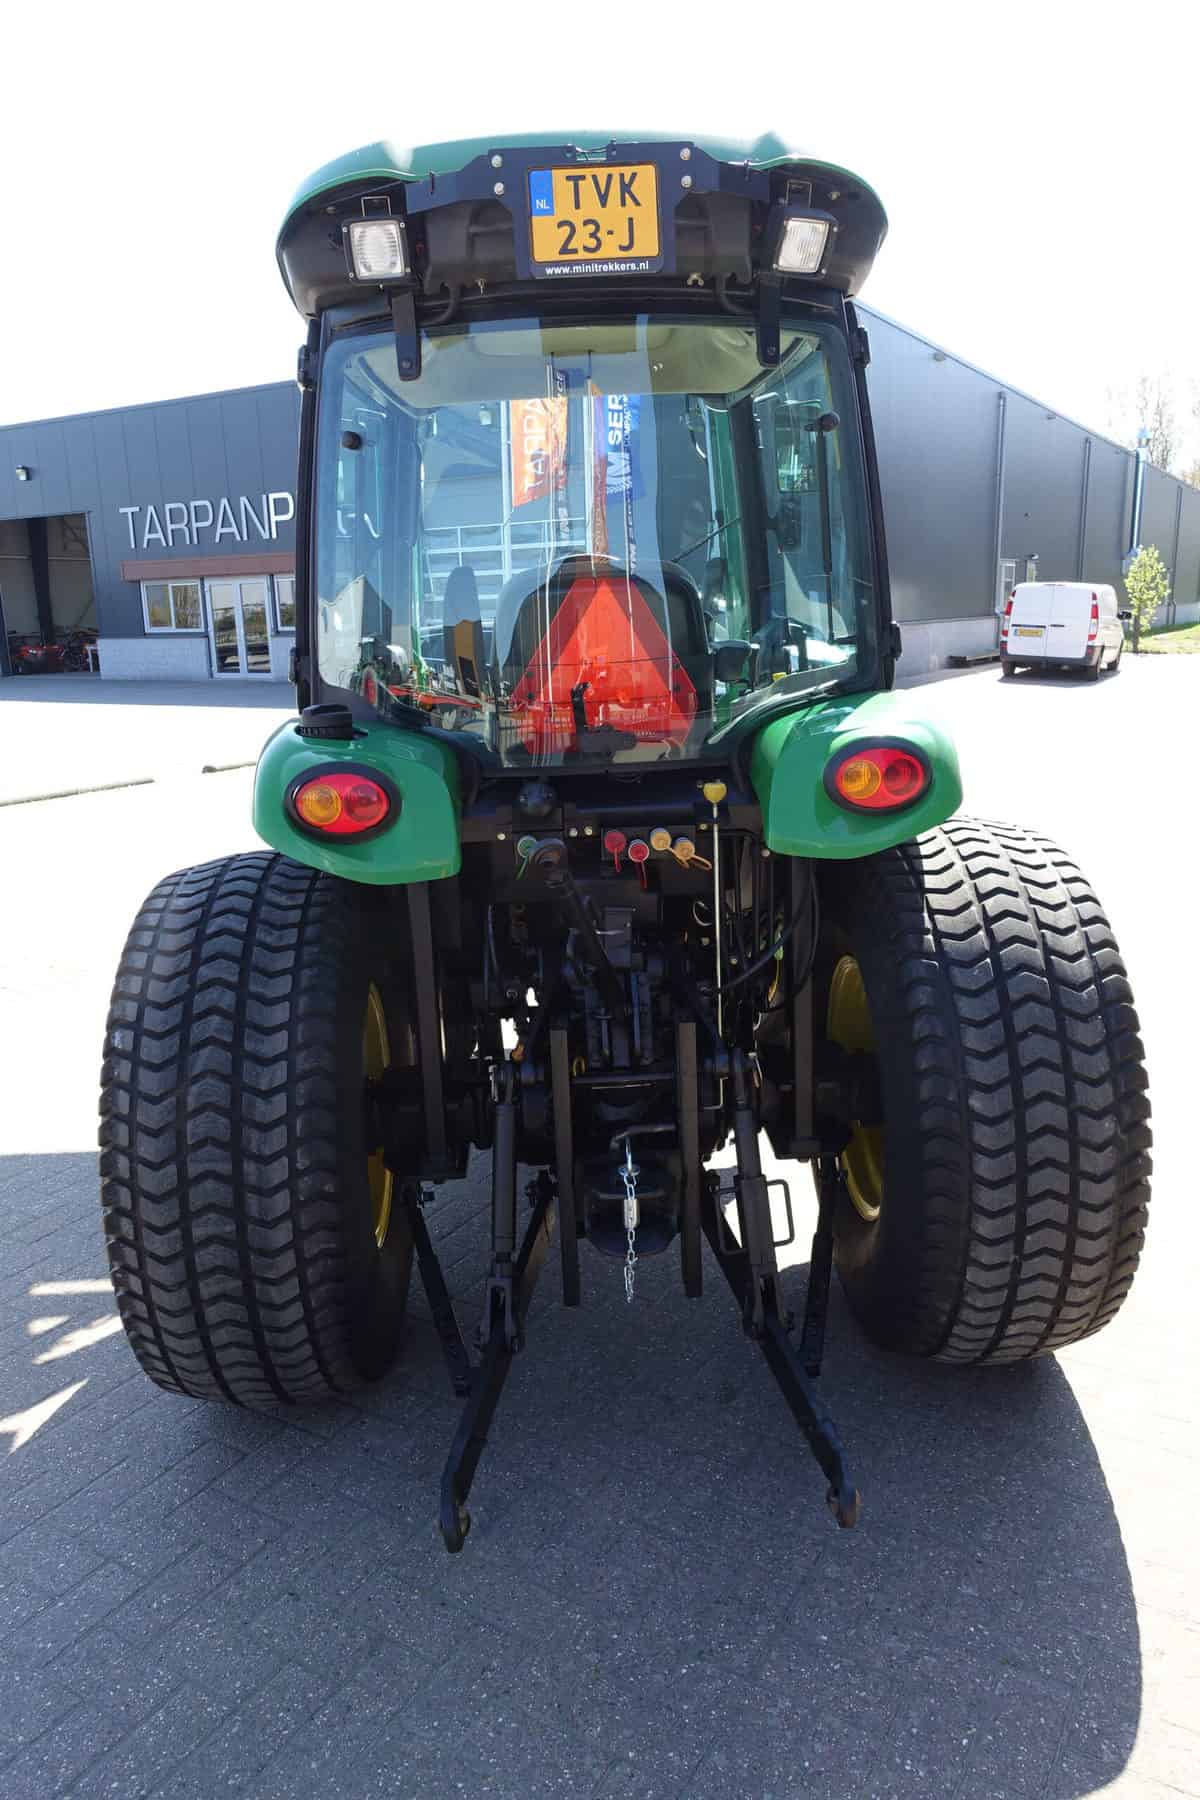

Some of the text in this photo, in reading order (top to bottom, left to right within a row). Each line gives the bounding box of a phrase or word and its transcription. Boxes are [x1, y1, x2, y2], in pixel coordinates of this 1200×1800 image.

[565, 172, 641, 209] TVK
[535, 200, 549, 209] NL
[557, 217, 634, 255] 23-J
[546, 261, 649, 275] www.minitrekkers.nl
